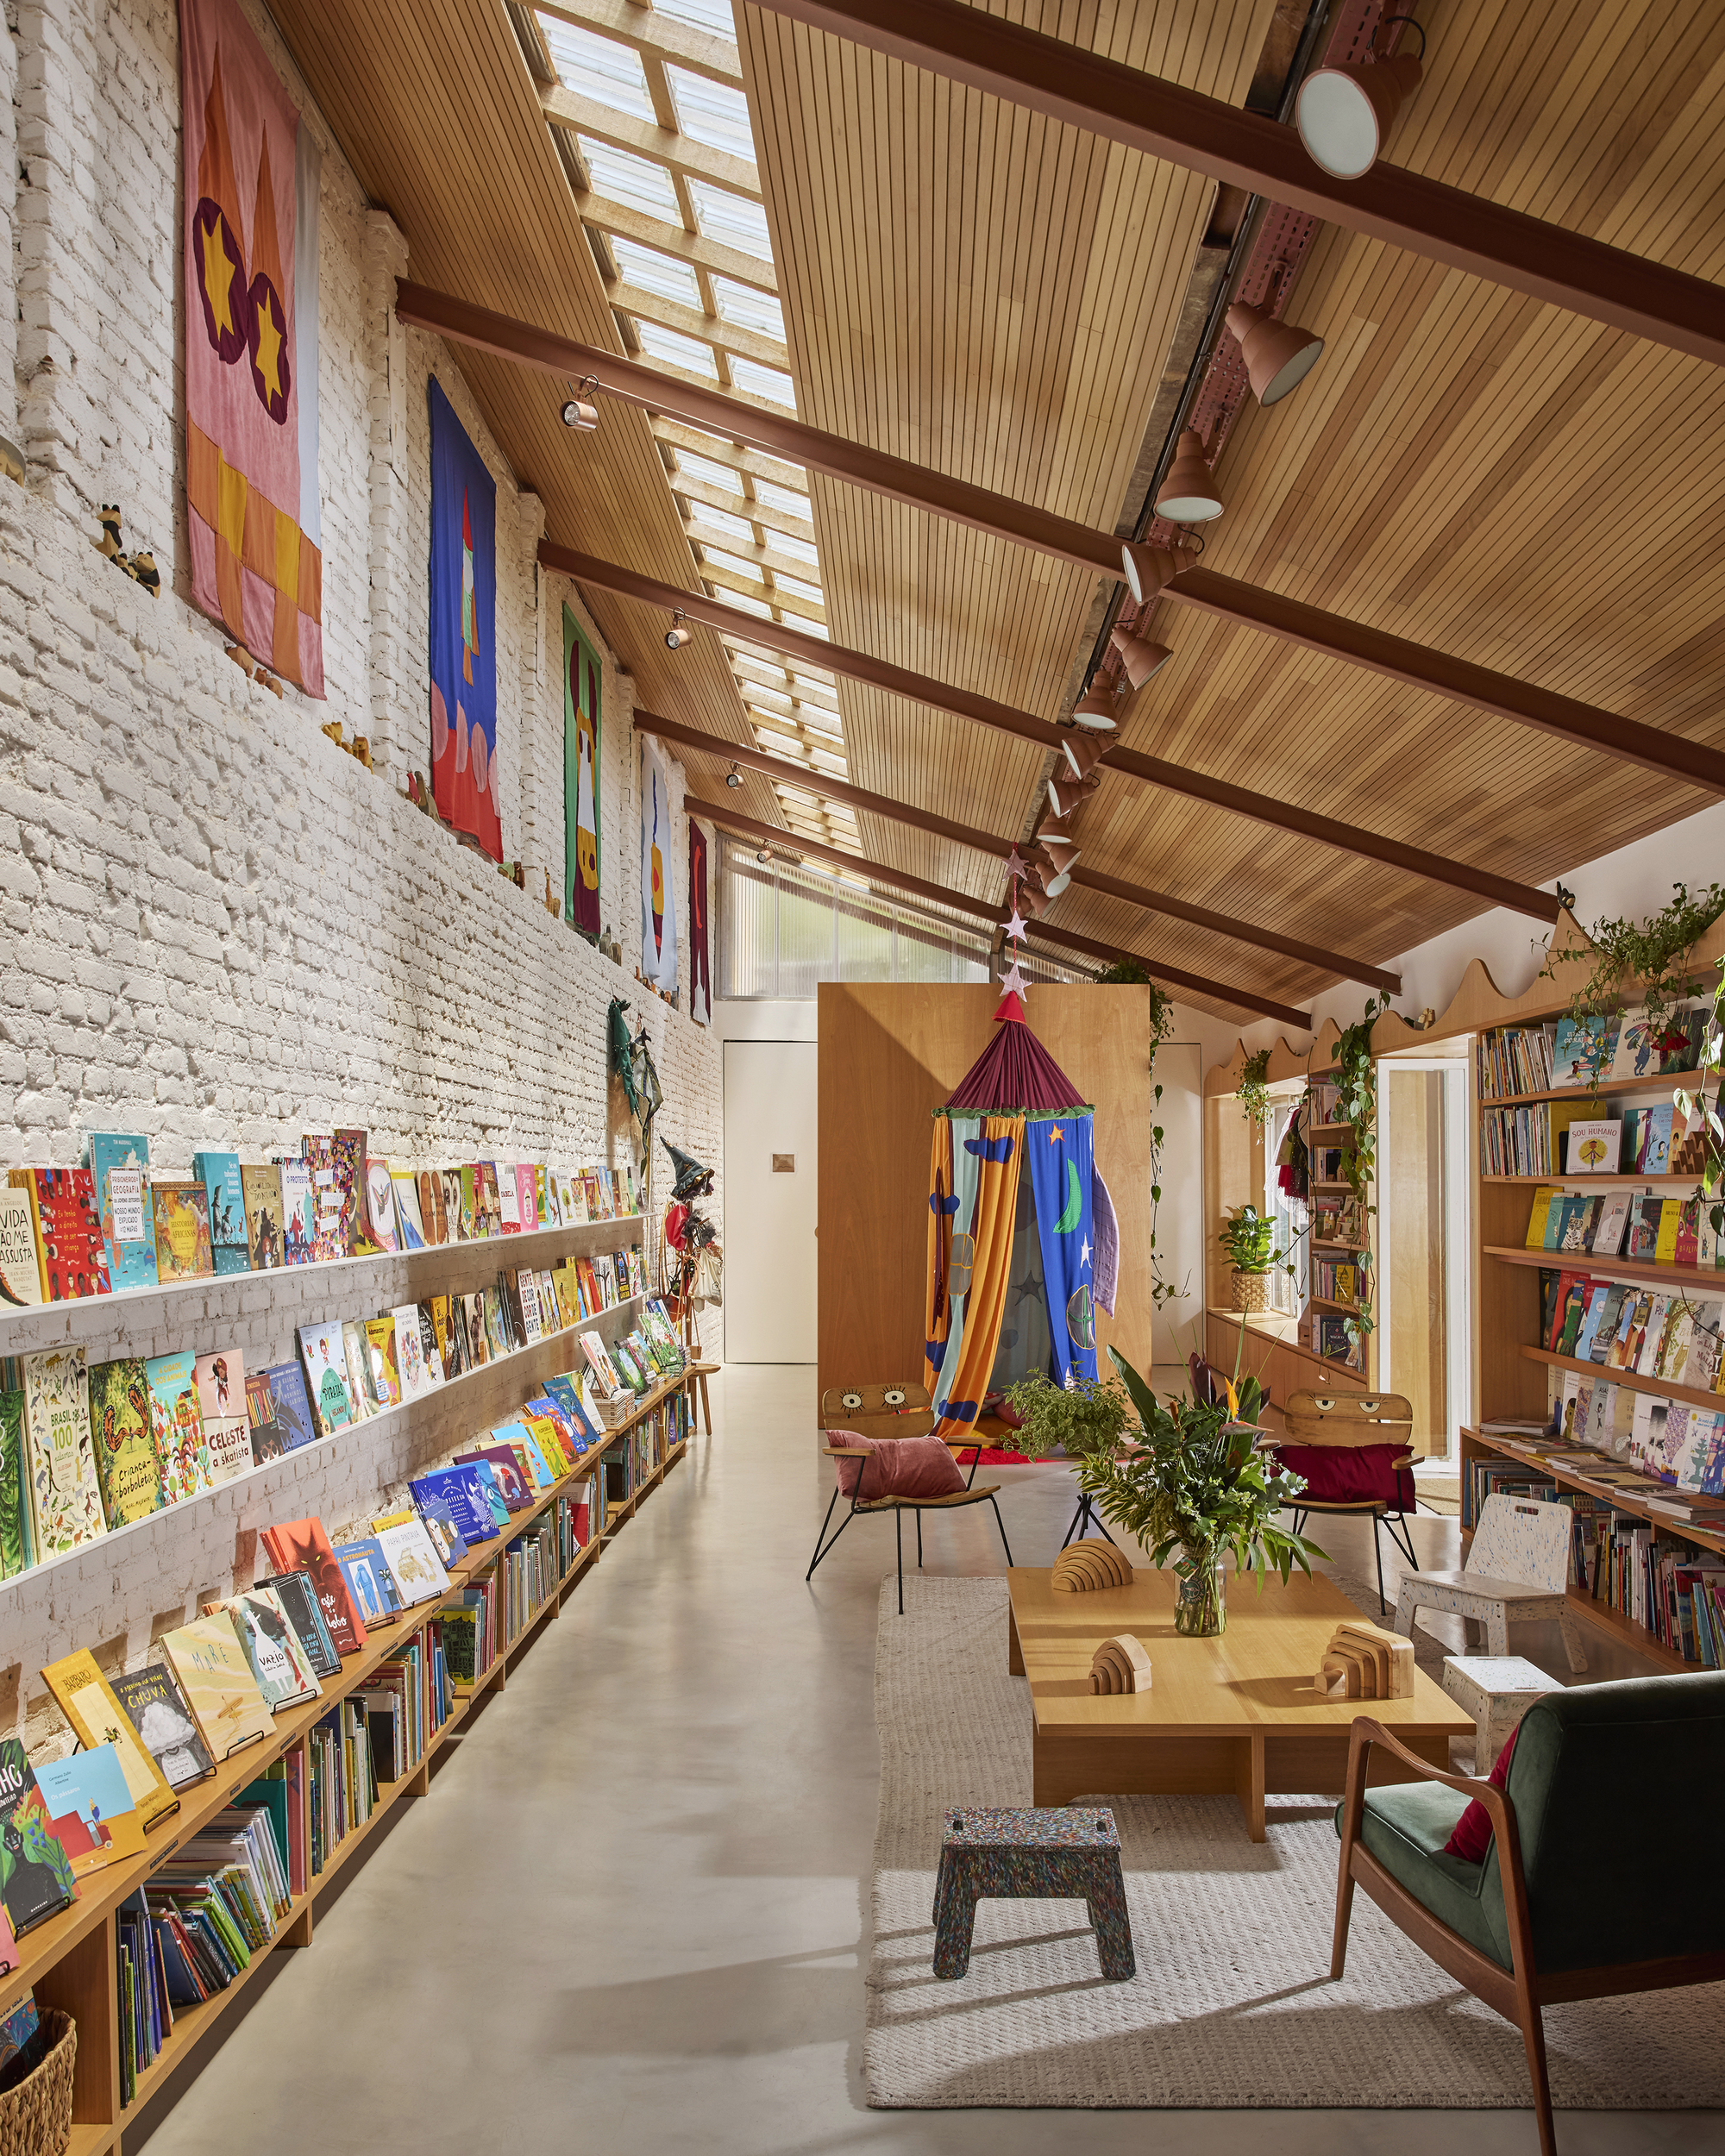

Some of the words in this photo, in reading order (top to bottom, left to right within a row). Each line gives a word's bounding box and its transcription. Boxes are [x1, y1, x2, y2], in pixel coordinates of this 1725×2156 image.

[1572, 1129, 1585, 1138] SOU
[1589, 1128, 1617, 1137] HUMANO
[113, 1185, 139, 1194] GEOGRAFIA
[322, 1194, 344, 1204] PESSOAS
[0, 1209, 28, 1228] VIDA
[64, 1209, 76, 1218] tenho
[171, 1219, 195, 1228] HISTÓRIAS
[321, 1219, 338, 1230] CONTAM
[0, 1229, 12, 1247] ÃO
[14, 1230, 28, 1245] ME
[172, 1228, 196, 1238] AFRICANAS
[0, 1247, 34, 1264] ASSUSTA
[64, 1244, 79, 1253] criança
[519, 1273, 533, 1288] GENTE
[526, 1318, 539, 1334] GENTE
[163, 1362, 181, 1373] CIDADE
[155, 1376, 166, 1385] DOS
[167, 1369, 187, 1382] ANIMAIS
[284, 1389, 302, 1399] MENINOS
[290, 1395, 305, 1406] SABIDOS
[246, 1388, 276, 1429] MORAS
[51, 1409, 71, 1426] BRASIL
[53, 1425, 72, 1451] 100
[209, 1425, 248, 1451] CELESTE,
[54, 1451, 74, 1464] palavras
[212, 1458, 219, 1468] a
[221, 1447, 249, 1465] skatista
[386, 1537, 399, 1547] PAPAI
[400, 1530, 420, 1543] PINTAVA
[342, 1549, 374, 1562] ASTRONAUTA
[321, 1593, 336, 1608] este
[325, 1614, 348, 1629] lobo
[191, 1643, 229, 1674] MARÉ
[259, 1651, 284, 1665] VAZIO
[124, 1682, 141, 1692] MENINO
[149, 1673, 163, 1683] VIROU
[128, 1684, 167, 1708] CHUVA
[48, 1773, 61, 1782] Germano
[59, 1786, 80, 1800] pássaros
